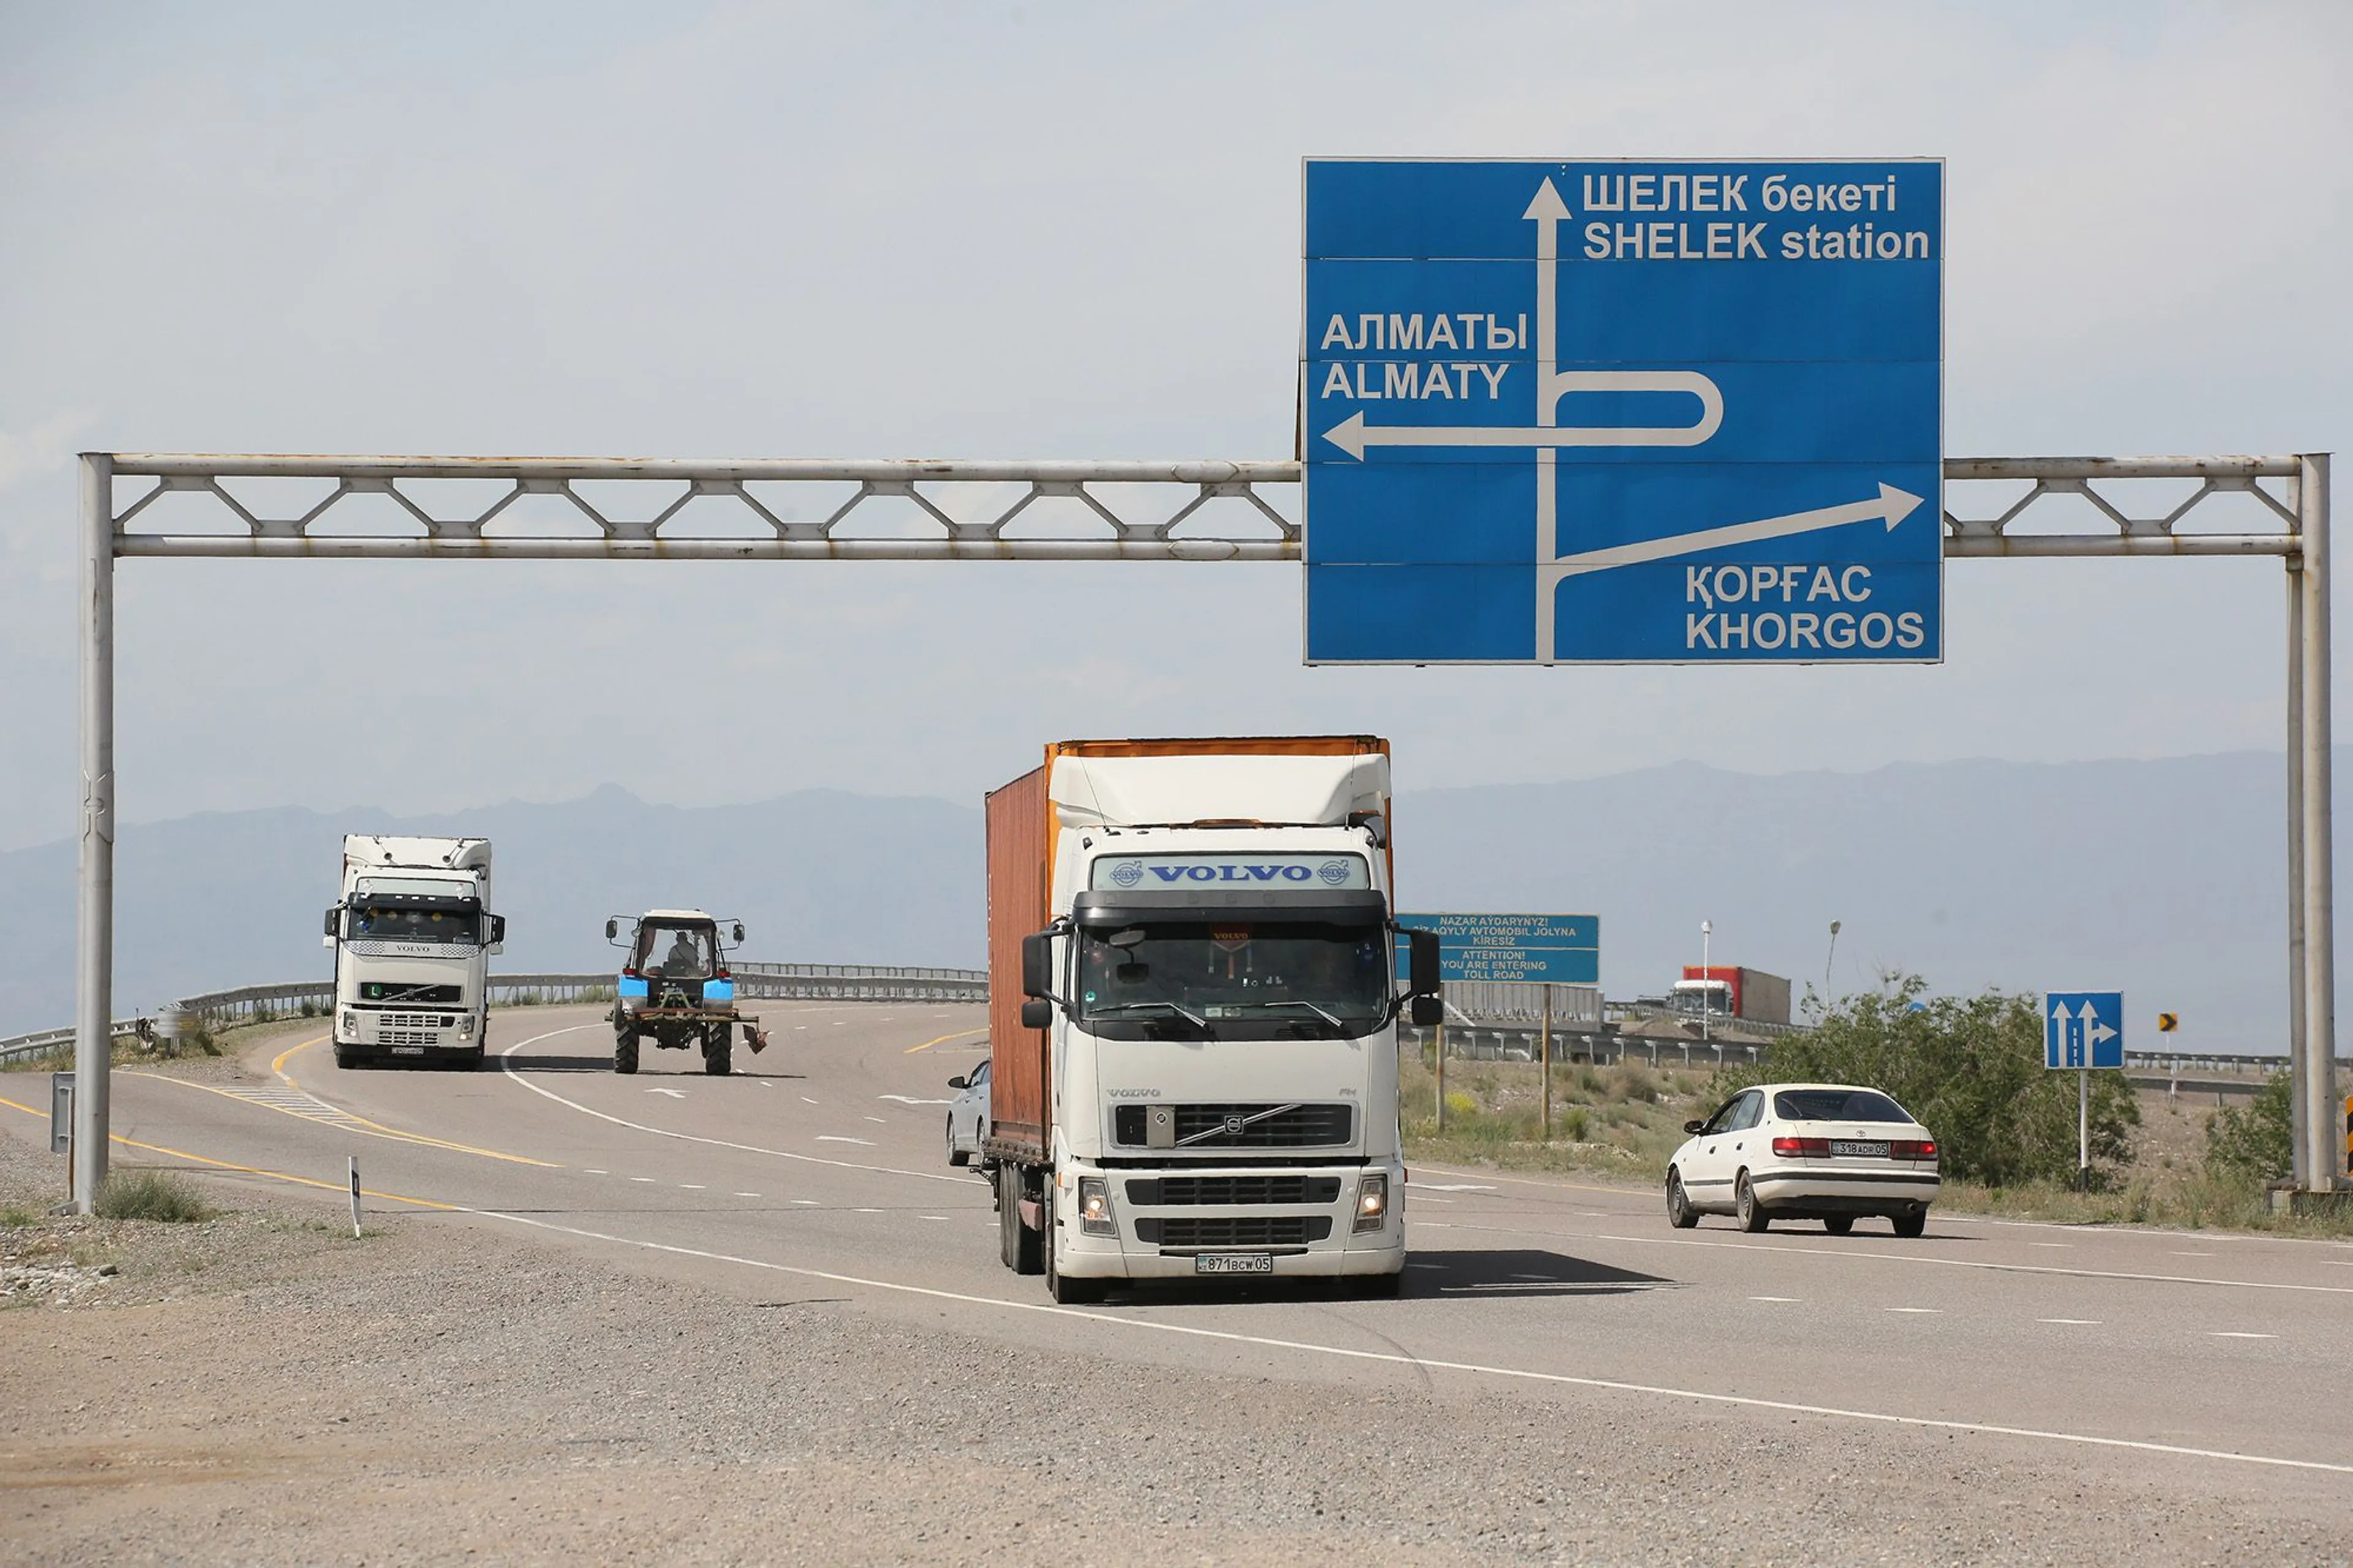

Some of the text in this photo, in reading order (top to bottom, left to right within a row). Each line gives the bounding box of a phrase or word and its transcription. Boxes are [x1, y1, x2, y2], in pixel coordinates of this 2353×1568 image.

[1584, 175, 1895, 211] ШЕЛЕК бекеті
[1584, 222, 1928, 259] SHELEK station
[1320, 314, 1526, 350] АЛМАТЫ
[1321, 363, 1509, 400] ALMATY
[1687, 566, 1871, 609] ҚОРҒАС
[1687, 612, 1924, 649] KHORGOS
[1148, 865, 1312, 881] VOLVO
[1440, 917, 1477, 925] NAZAR
[1534, 927, 1576, 936] JOLYNA
[1462, 950, 1525, 960] ATTENTION!
[1441, 960, 1547, 970] YOU ARE ENTERING
[1463, 970, 1525, 979] TOLL ROAD
[371, 987, 377, 996] L
[1107, 1088, 1161, 1097] VOLVO
